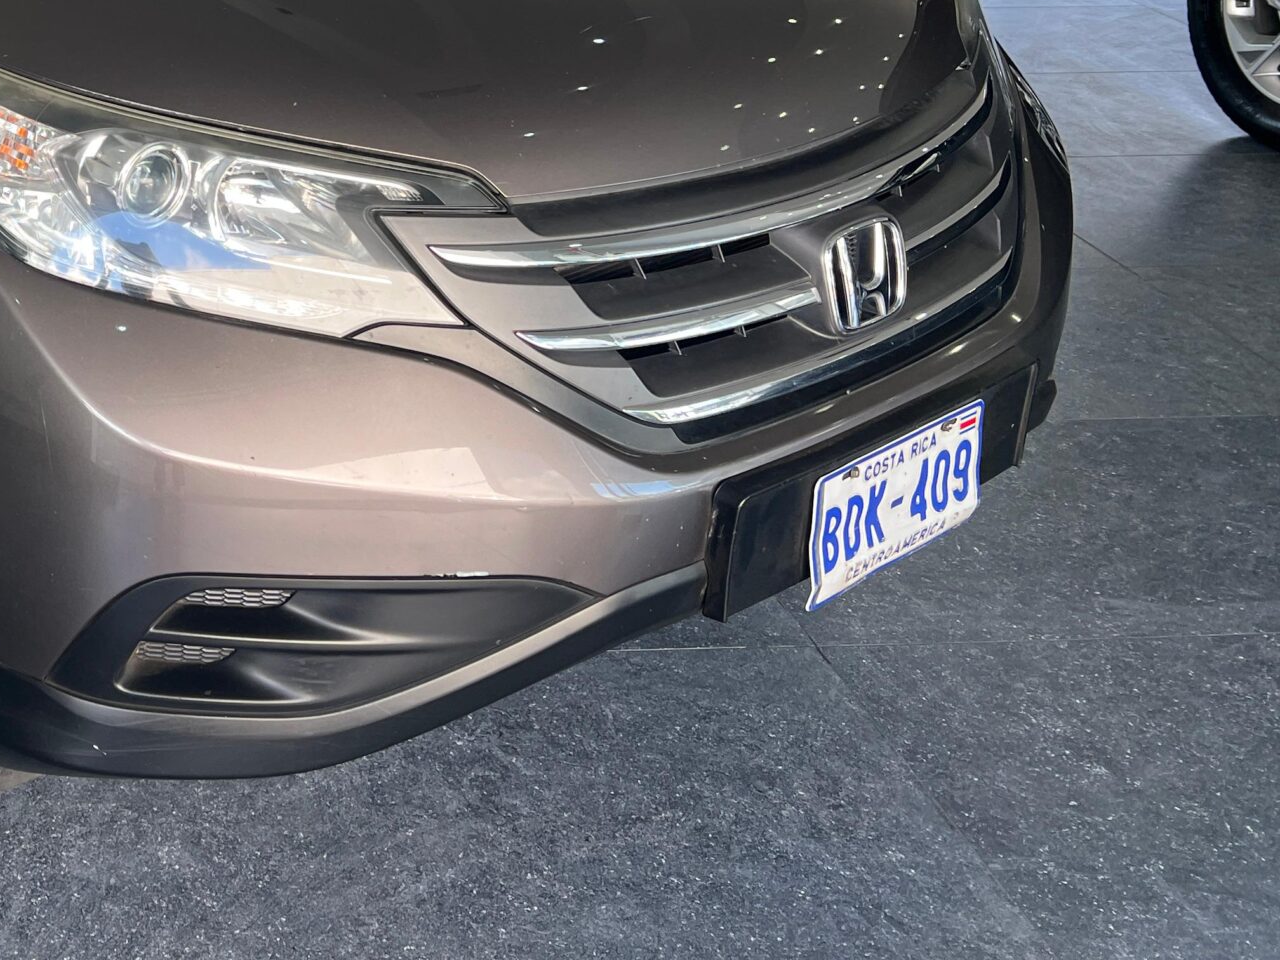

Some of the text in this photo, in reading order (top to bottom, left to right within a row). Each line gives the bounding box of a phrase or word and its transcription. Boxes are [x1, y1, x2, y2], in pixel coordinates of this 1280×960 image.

[864, 432, 938, 482] COSTA RICA
[822, 439, 972, 575] BDK-409
[844, 520, 947, 582] CENTROAMERICA
